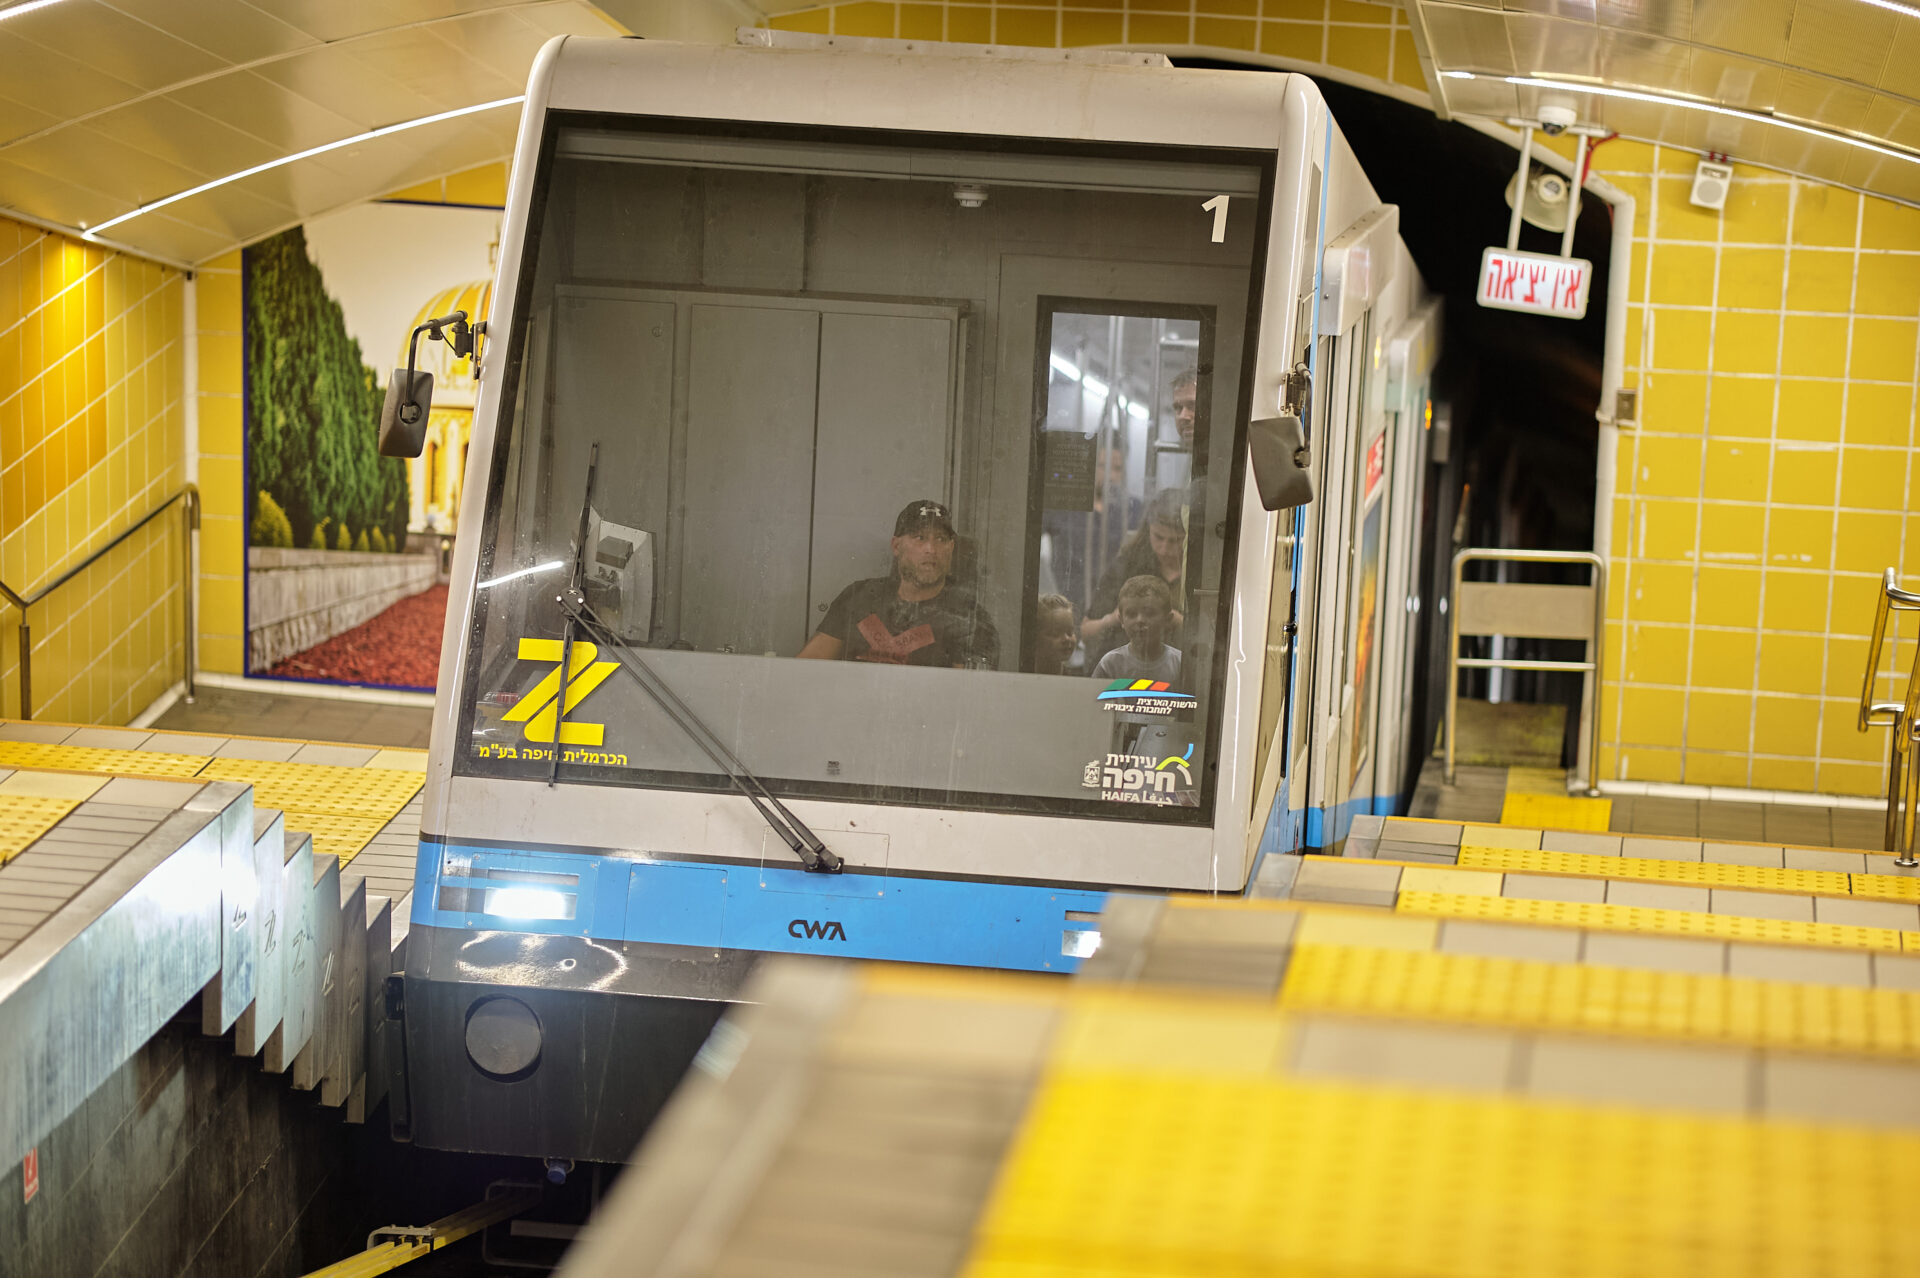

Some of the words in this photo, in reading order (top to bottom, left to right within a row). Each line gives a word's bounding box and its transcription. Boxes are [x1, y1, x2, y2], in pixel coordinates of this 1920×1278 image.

[1201, 195, 1229, 243] 1
[1486, 259, 1547, 303] יציאה
[1551, 268, 1583, 310] אין
[1104, 703, 1135, 712] ציבורית
[1135, 705, 1172, 715] לתחבורה
[1137, 698, 1168, 707] הארצית
[1169, 700, 1198, 708] הרשות
[563, 749, 628, 766] הכרמלית
[1105, 753, 1157, 769] עיריית
[1102, 767, 1176, 793] חיפה
[1101, 790, 1140, 803] HAIFA
[788, 919, 847, 941] CWA
